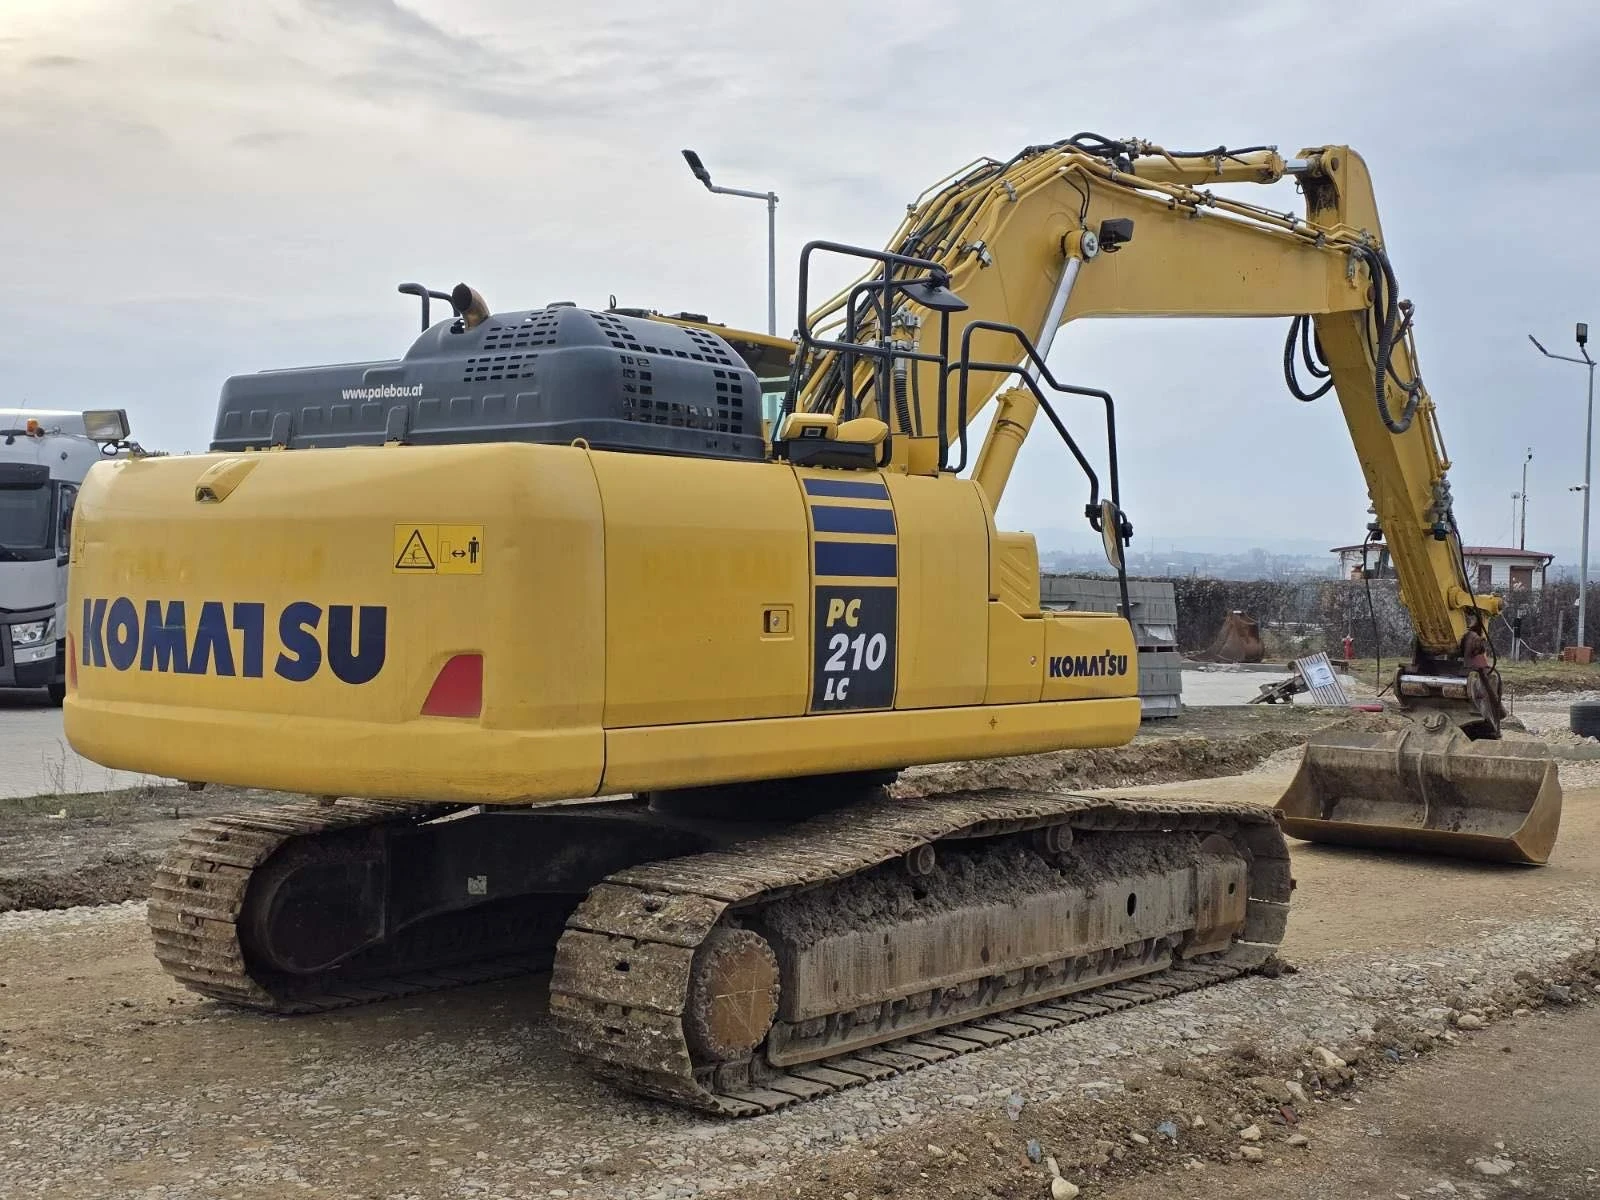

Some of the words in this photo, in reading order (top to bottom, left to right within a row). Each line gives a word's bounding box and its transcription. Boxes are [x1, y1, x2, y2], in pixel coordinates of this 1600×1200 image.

[342, 383, 423, 402] www.palebau.at
[826, 598, 862, 627] PC
[82, 597, 387, 684] KOMATSU
[824, 633, 887, 671] 210
[1050, 649, 1127, 678] KOMATSU
[823, 677, 850, 700] LC
